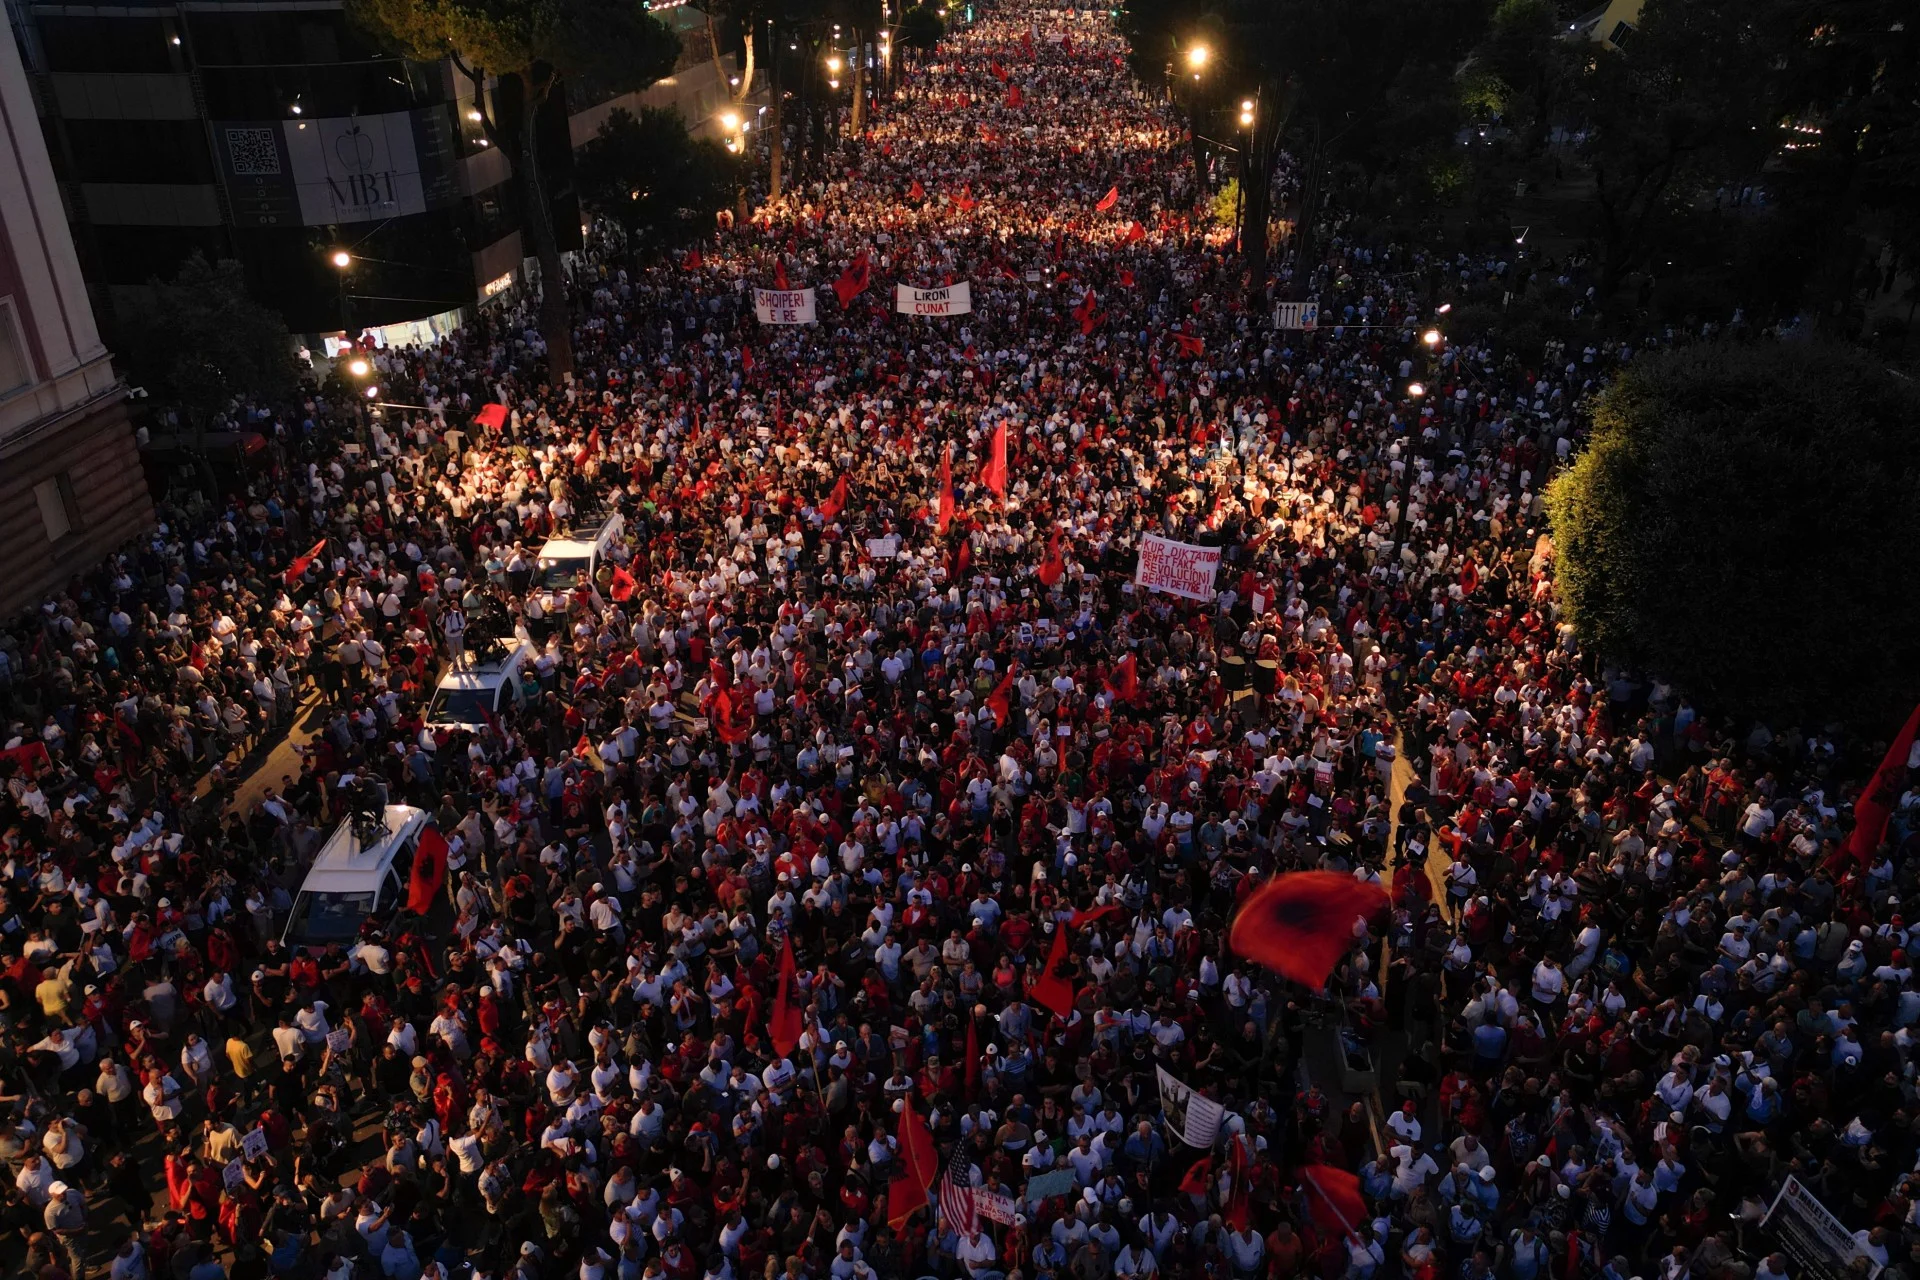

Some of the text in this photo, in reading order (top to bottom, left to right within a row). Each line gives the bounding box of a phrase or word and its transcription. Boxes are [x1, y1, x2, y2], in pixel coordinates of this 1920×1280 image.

[327, 171, 397, 206] MBT
[758, 290, 804, 308] SHQIPËRI
[914, 288, 950, 300] LIRONI
[769, 309, 797, 322] E RE
[915, 301, 950, 314] ÇUNAT
[1142, 551, 1170, 565] BEHET
[1143, 539, 1221, 562] KUR DIKTATURA
[1142, 572, 1170, 588] BEHET
[1798, 1191, 1823, 1219] MALET
